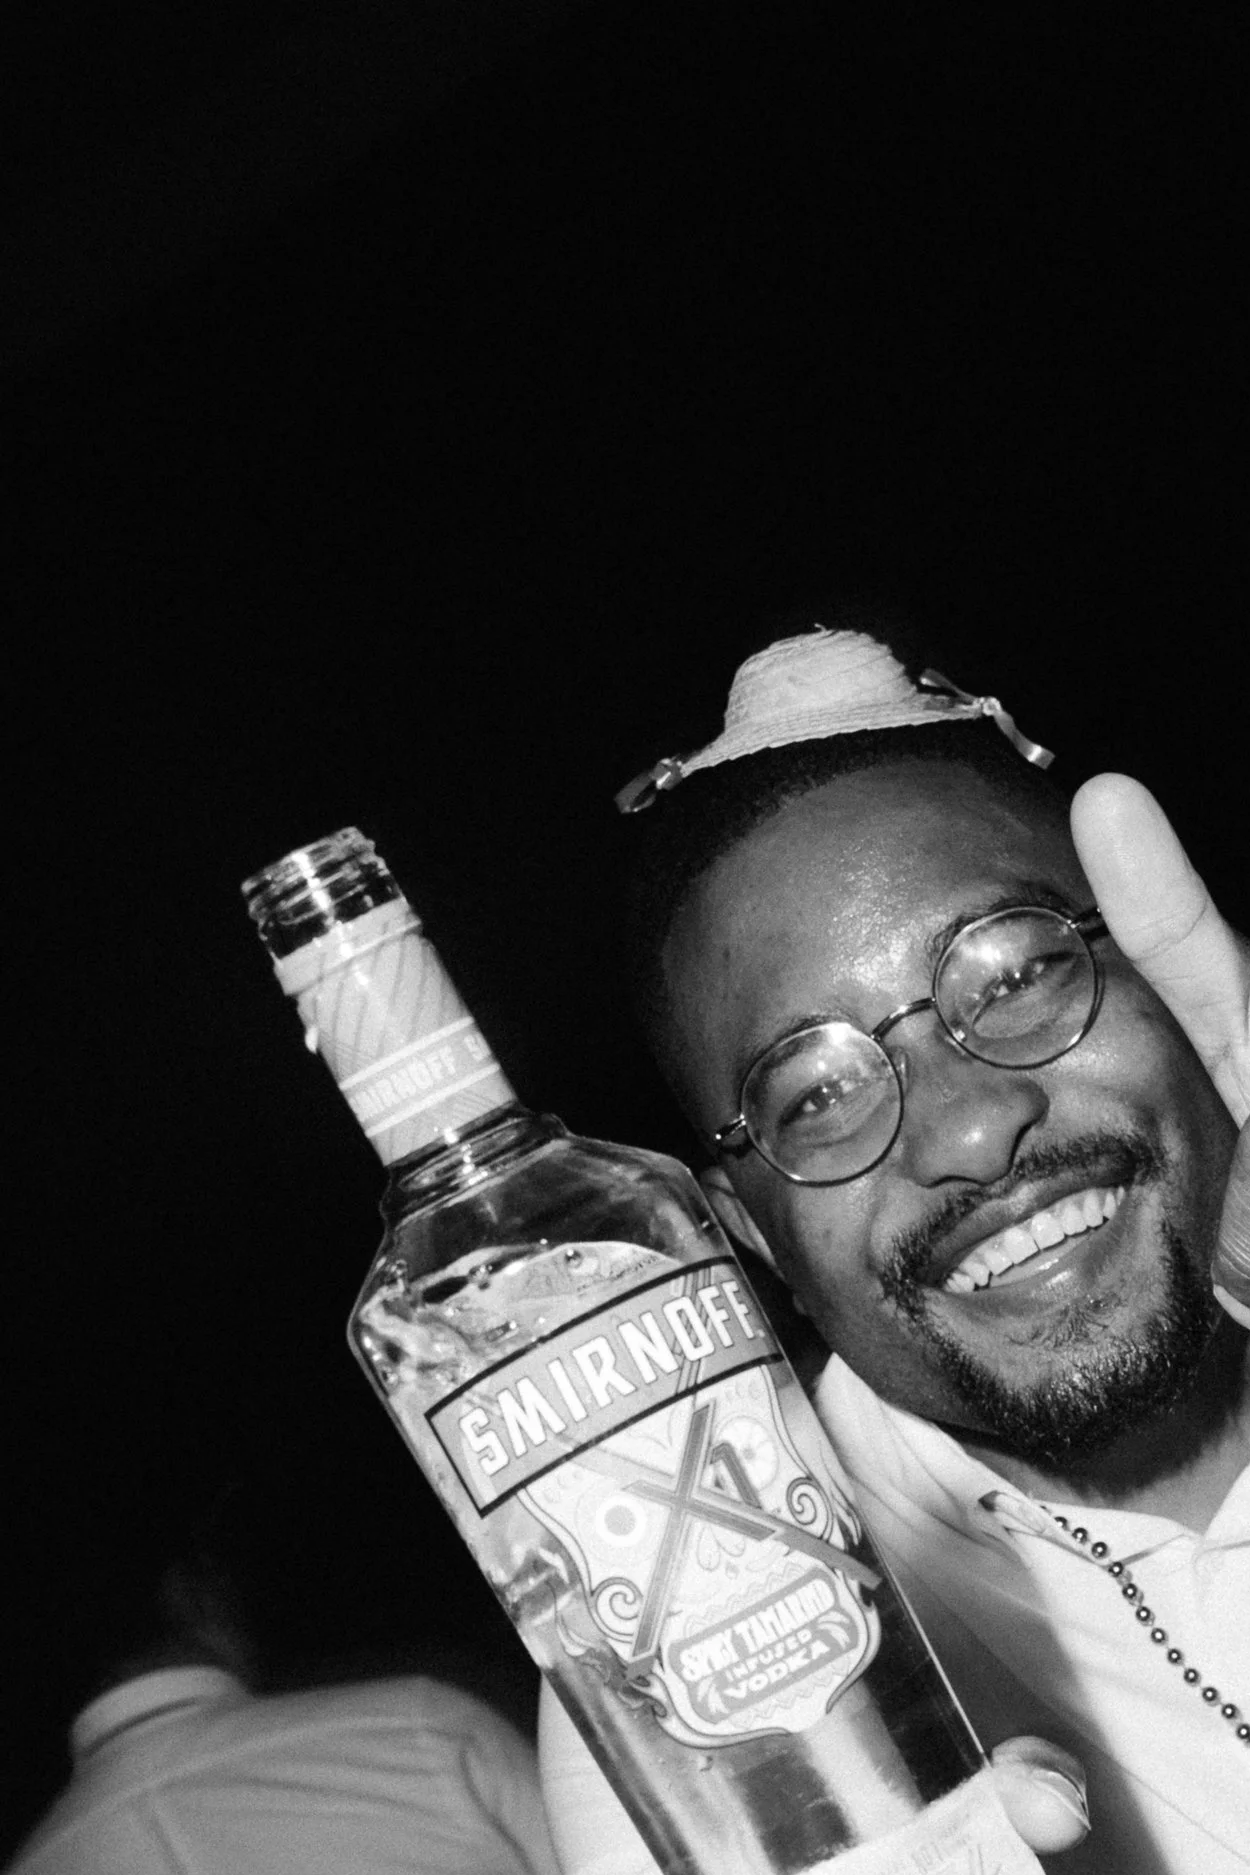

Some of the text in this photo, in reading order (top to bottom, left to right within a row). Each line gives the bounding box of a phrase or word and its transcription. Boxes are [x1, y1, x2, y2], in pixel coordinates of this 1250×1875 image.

[458, 1280, 755, 1477] SMIRNOFF
[732, 1578, 835, 1656] TAMARIND
[723, 1639, 831, 1699] VODKA
[724, 1628, 812, 1683] INFUSED
